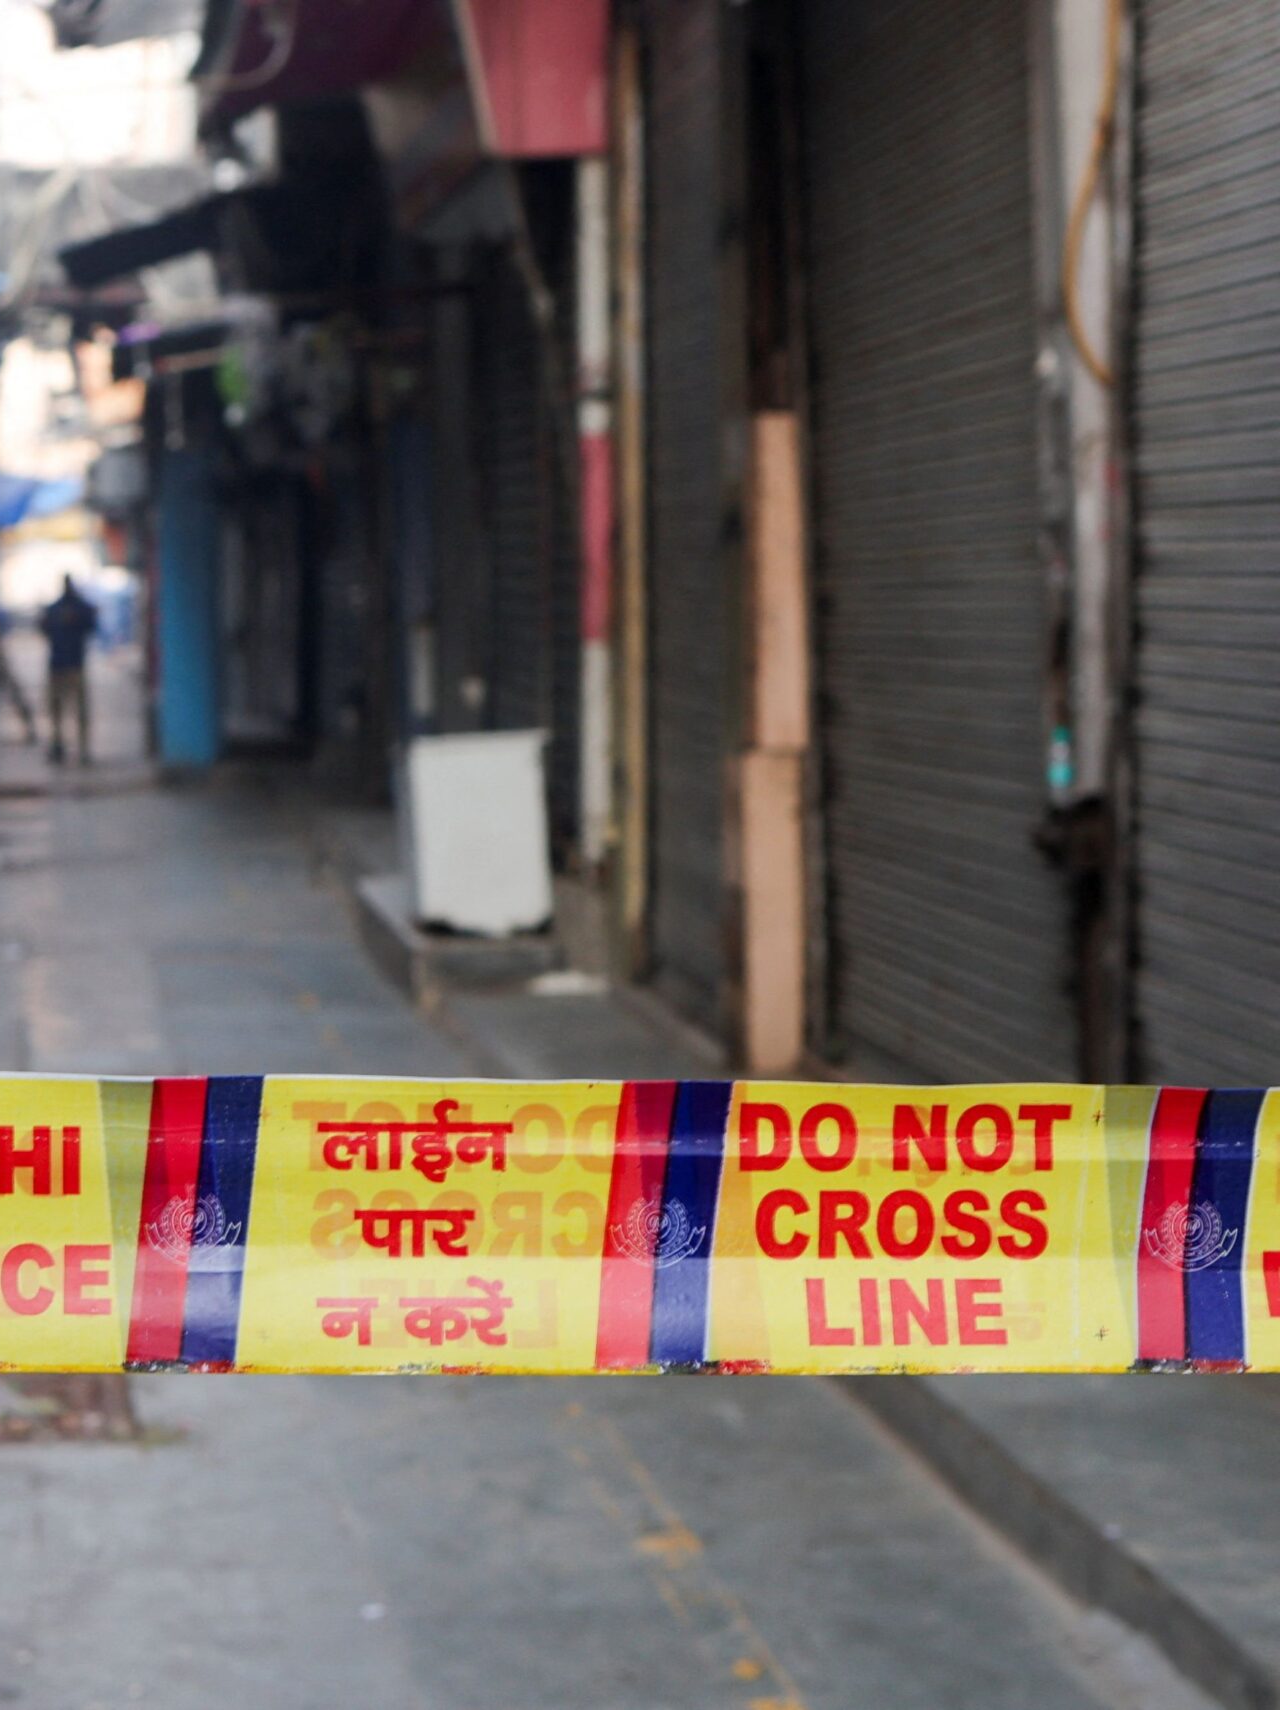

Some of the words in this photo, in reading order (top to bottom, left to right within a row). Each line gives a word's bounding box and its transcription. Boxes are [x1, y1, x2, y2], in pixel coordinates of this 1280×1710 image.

[317, 1098, 514, 1183] लाईन
[738, 1102, 858, 1173] DO
[892, 1103, 1073, 1173] NOT
[353, 1209, 476, 1258] पार
[755, 1188, 1049, 1260] CROSS
[317, 1298, 379, 1346] न
[399, 1276, 514, 1347] करें
[805, 1278, 1008, 1347] LINE
